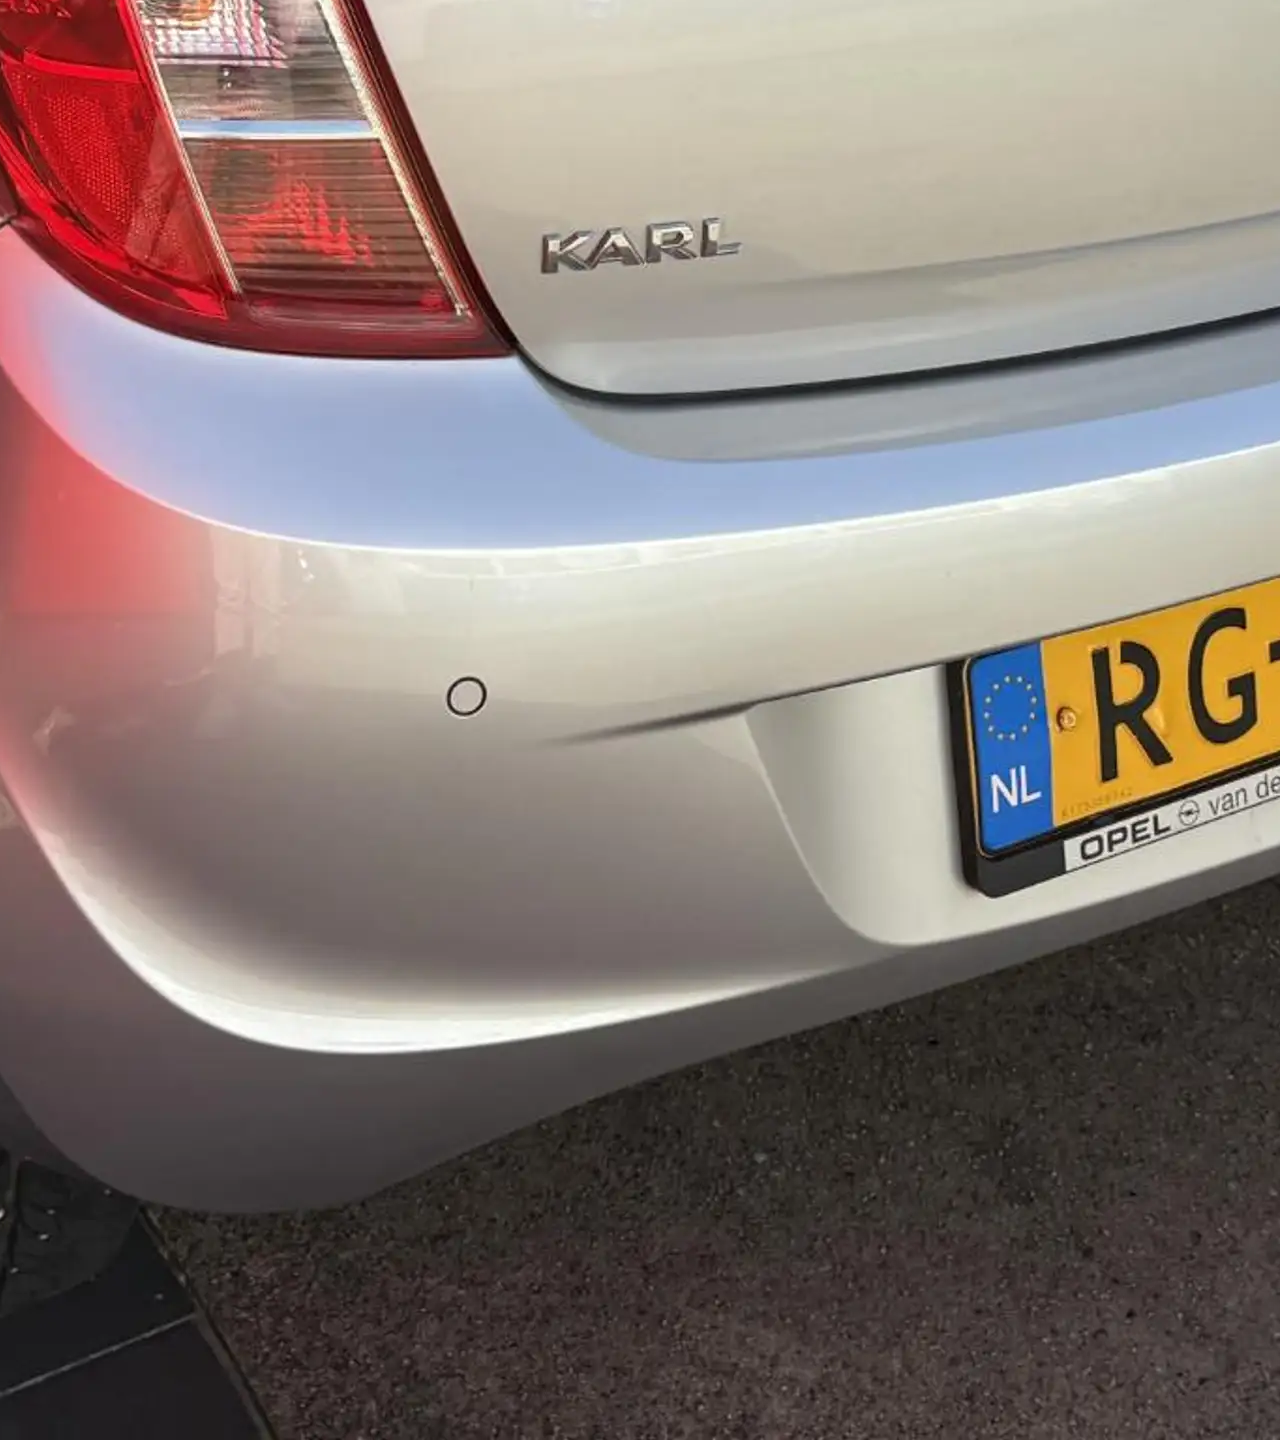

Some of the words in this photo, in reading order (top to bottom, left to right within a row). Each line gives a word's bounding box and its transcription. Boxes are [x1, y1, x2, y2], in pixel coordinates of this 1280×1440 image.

[540, 217, 743, 274] KARL
[991, 765, 1042, 813] NL
[1080, 813, 1172, 861] OPEL
[1208, 788, 1248, 817] van
